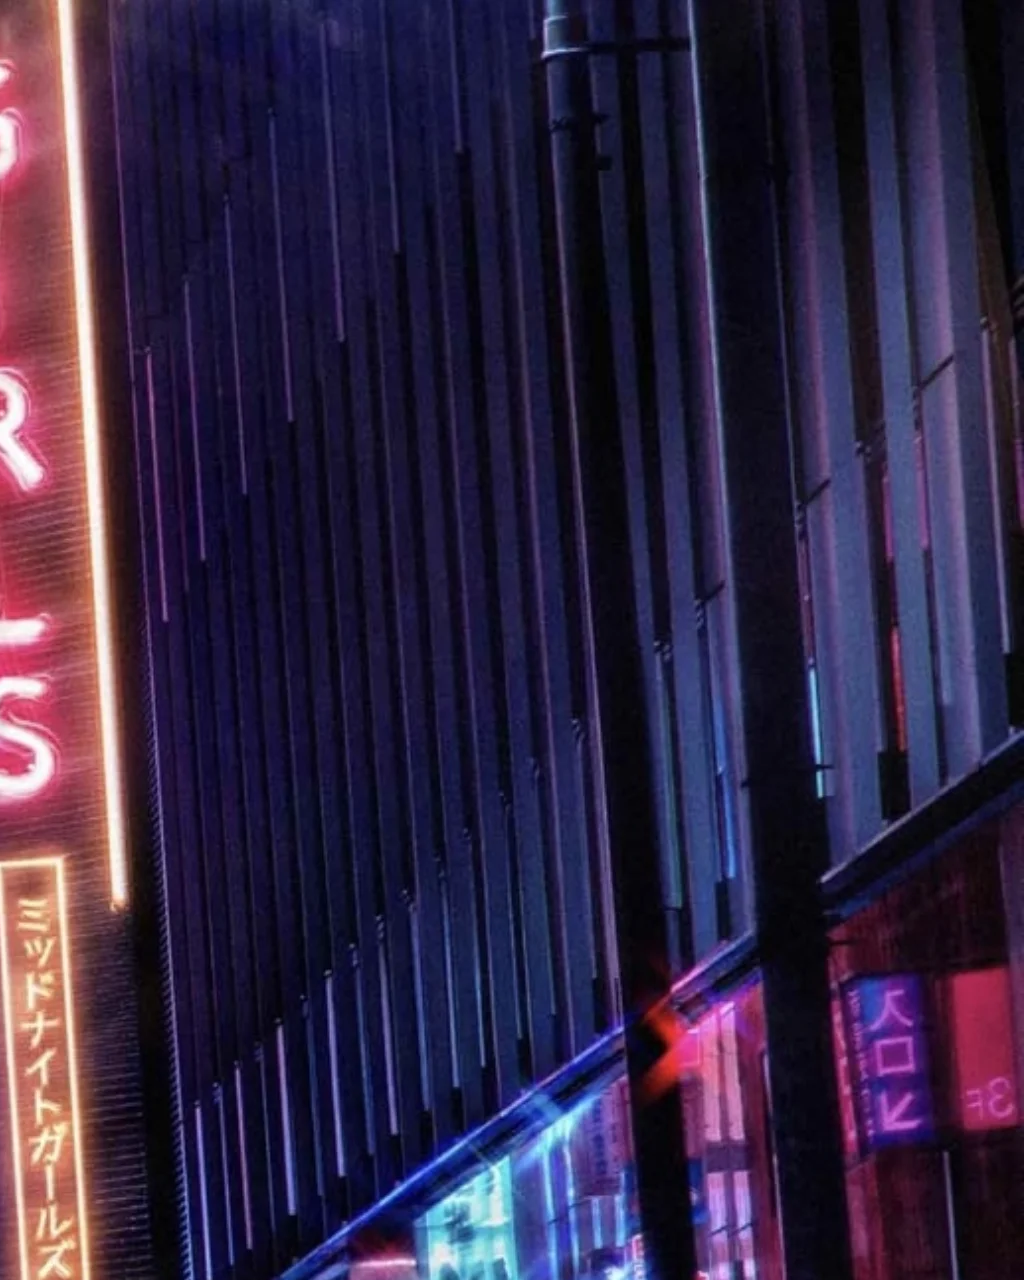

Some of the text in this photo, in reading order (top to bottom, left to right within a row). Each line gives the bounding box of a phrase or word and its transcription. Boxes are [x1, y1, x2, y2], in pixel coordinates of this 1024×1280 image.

[18, 898, 76, 1280] ミッドナイトガールズ
